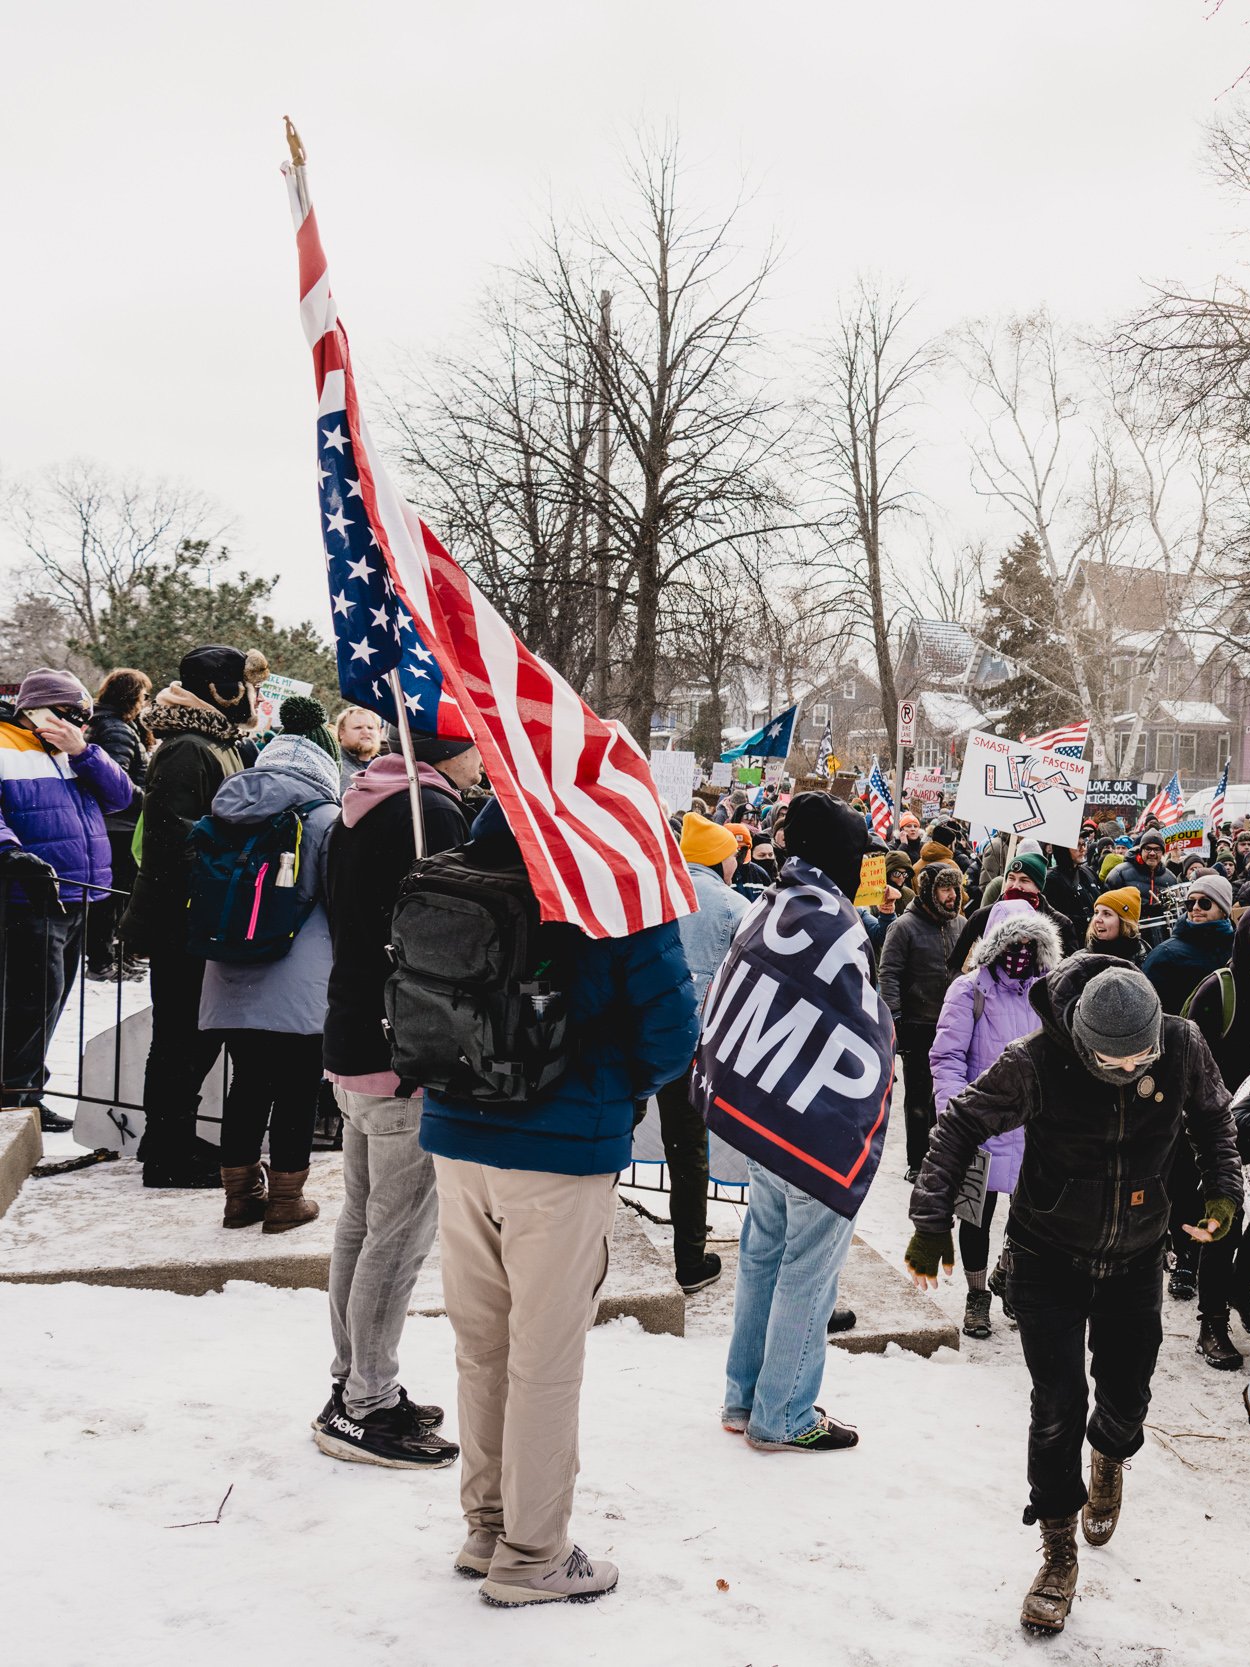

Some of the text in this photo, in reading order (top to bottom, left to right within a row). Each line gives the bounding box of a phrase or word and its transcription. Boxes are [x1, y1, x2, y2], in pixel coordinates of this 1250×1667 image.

[973, 736, 1010, 754] SMASH
[1042, 756, 1085, 775] FASCISM
[906, 772, 919, 782] ICE
[1088, 780, 1133, 792] LOVE OUR
[1016, 817, 1041, 830] TRUMP
[1164, 830, 1200, 845] CE OUT
[1169, 839, 1191, 850] MSP
[730, 884, 880, 1026] CK
[329, 1414, 365, 1440] HOKA
